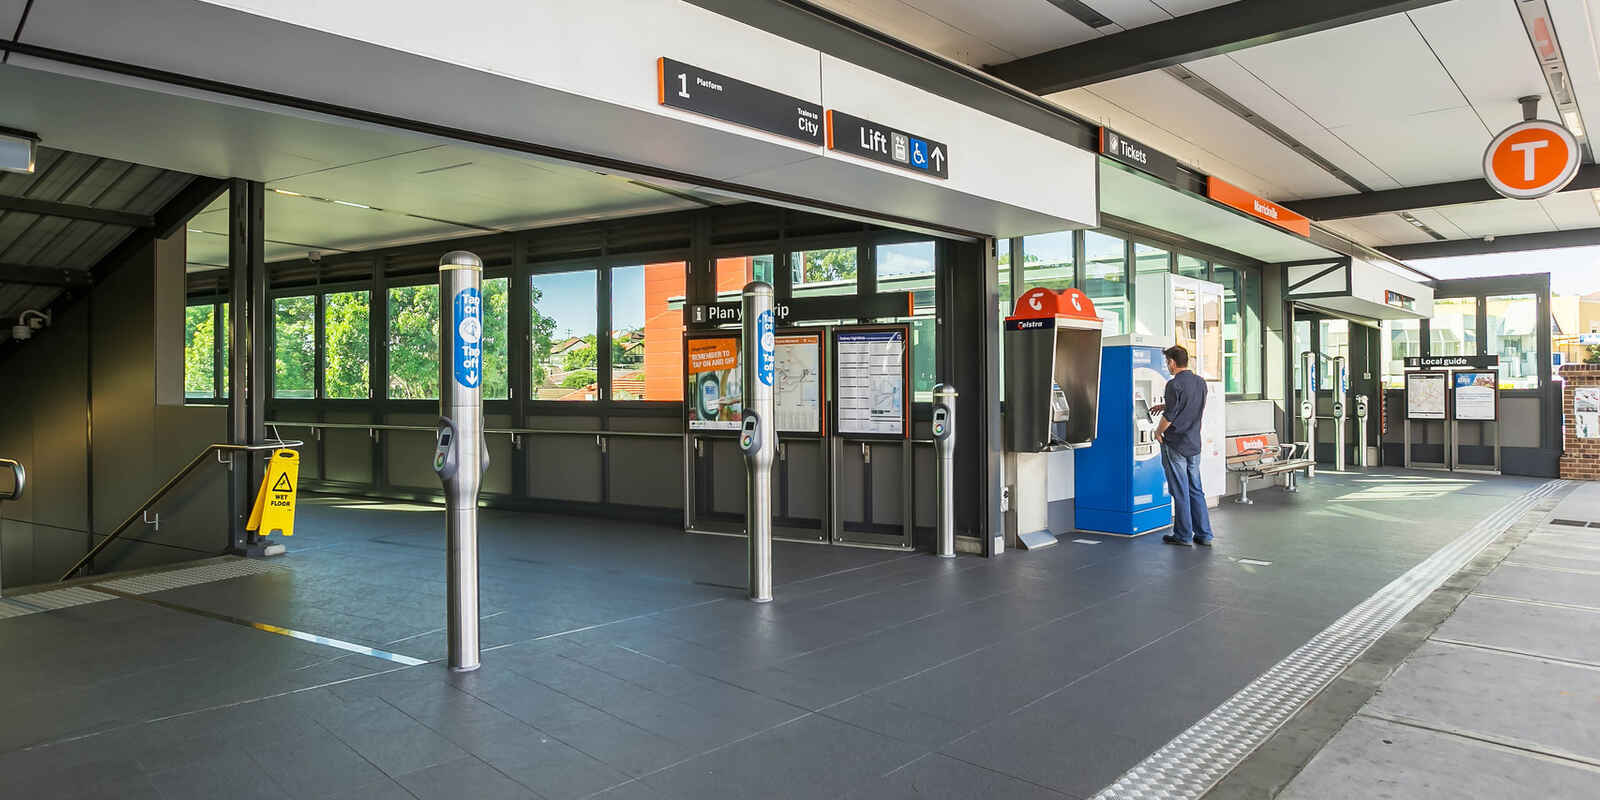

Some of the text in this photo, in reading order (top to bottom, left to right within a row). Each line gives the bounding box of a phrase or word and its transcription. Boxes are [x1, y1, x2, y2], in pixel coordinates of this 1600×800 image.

[677, 73, 690, 99] 1
[696, 77, 722, 92] Platform
[797, 107, 812, 117] Trains
[798, 117, 819, 137] City
[860, 126, 888, 155] Lift
[1120, 140, 1147, 164] Tickets
[1511, 140, 1549, 181] T
[462, 294, 480, 305] Tap
[464, 305, 479, 314] on
[708, 306, 735, 319] Plan
[462, 346, 480, 357] Tap
[1443, 358, 1467, 366] guide
